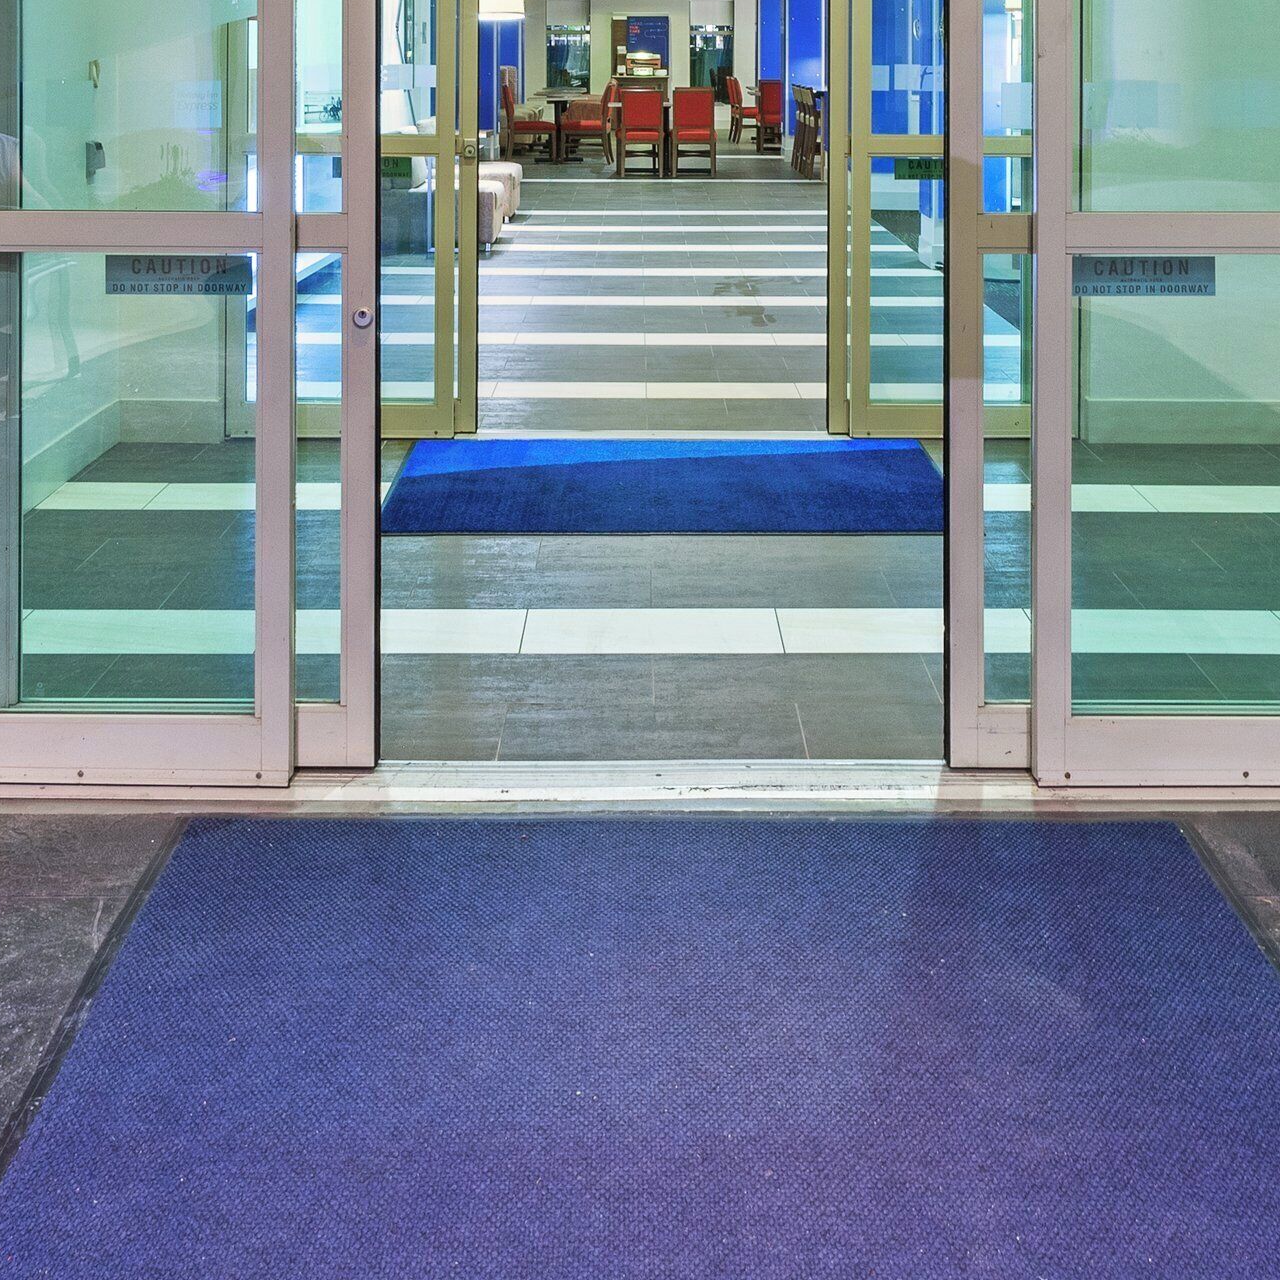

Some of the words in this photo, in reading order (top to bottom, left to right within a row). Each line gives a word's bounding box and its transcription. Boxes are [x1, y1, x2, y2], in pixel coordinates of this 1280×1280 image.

[909, 160, 943, 169] CAUTI
[132, 259, 227, 274] CAUTION
[1094, 259, 1190, 275] CAUTION
[113, 283, 126, 292] DO
[130, 283, 149, 292] NOT
[153, 283, 179, 292] STOP
[183, 283, 193, 292] IN
[198, 283, 247, 292] DOORWAY
[1074, 285, 1088, 294] DO
[1092, 285, 1111, 294] NOT
[1116, 285, 1141, 294] STOP
[1146, 285, 1155, 294] IN
[1160, 284, 1209, 293] DOORWAY
